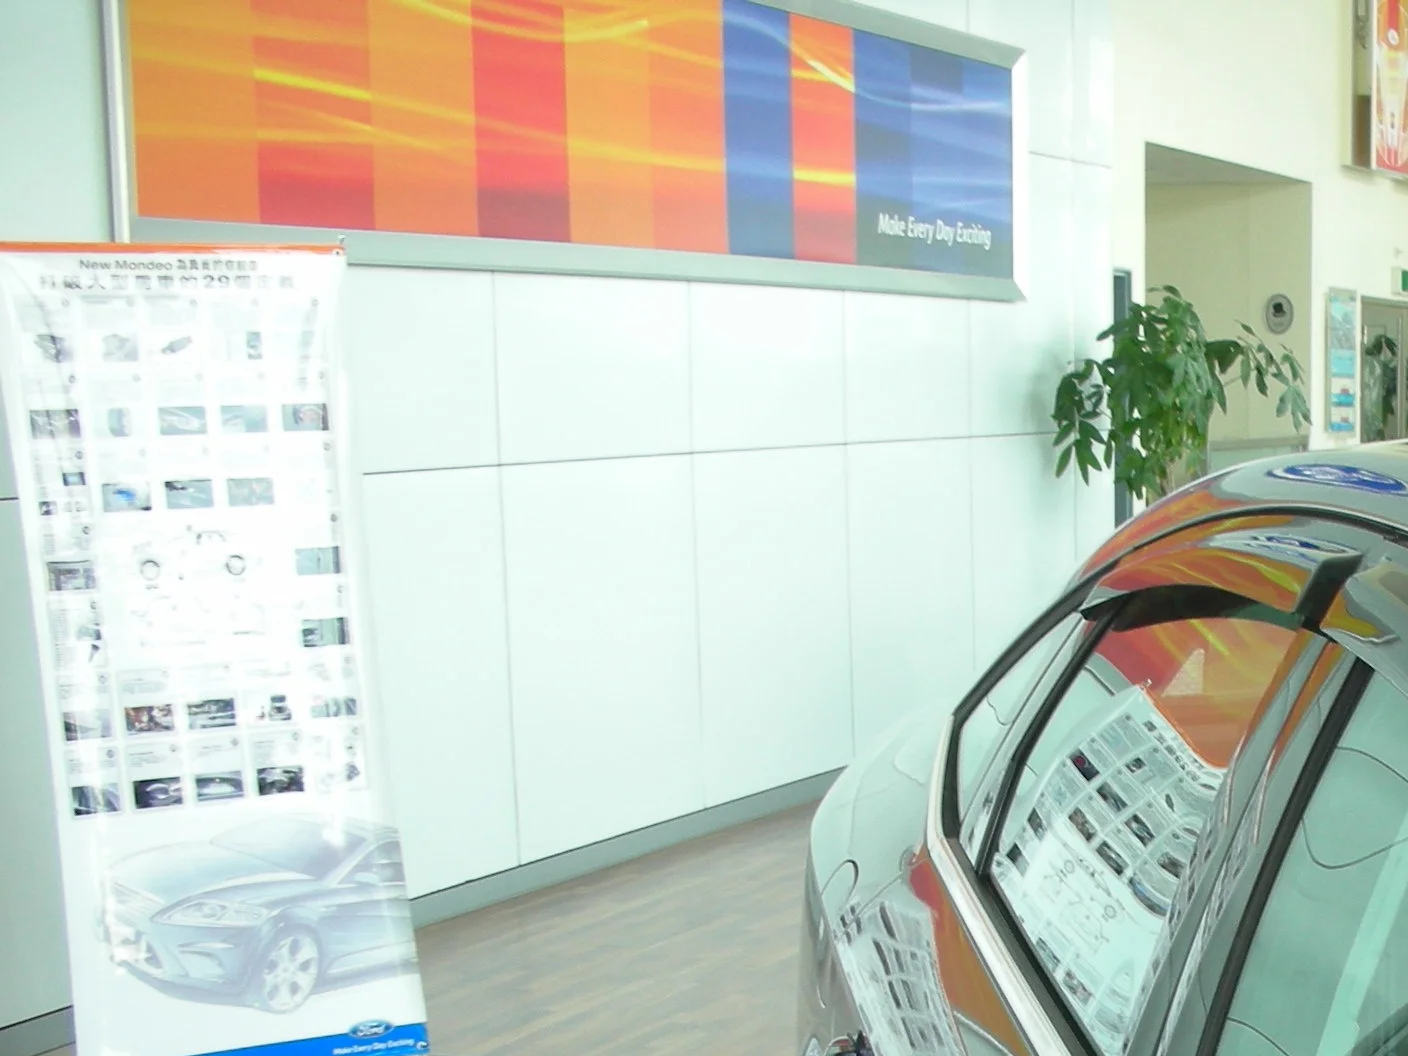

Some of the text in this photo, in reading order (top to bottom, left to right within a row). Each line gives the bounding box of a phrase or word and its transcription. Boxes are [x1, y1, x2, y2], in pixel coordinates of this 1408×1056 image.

[878, 212, 992, 251] Make Every Day Exciting
[79, 258, 111, 270] New
[115, 258, 173, 271] Mondeo
